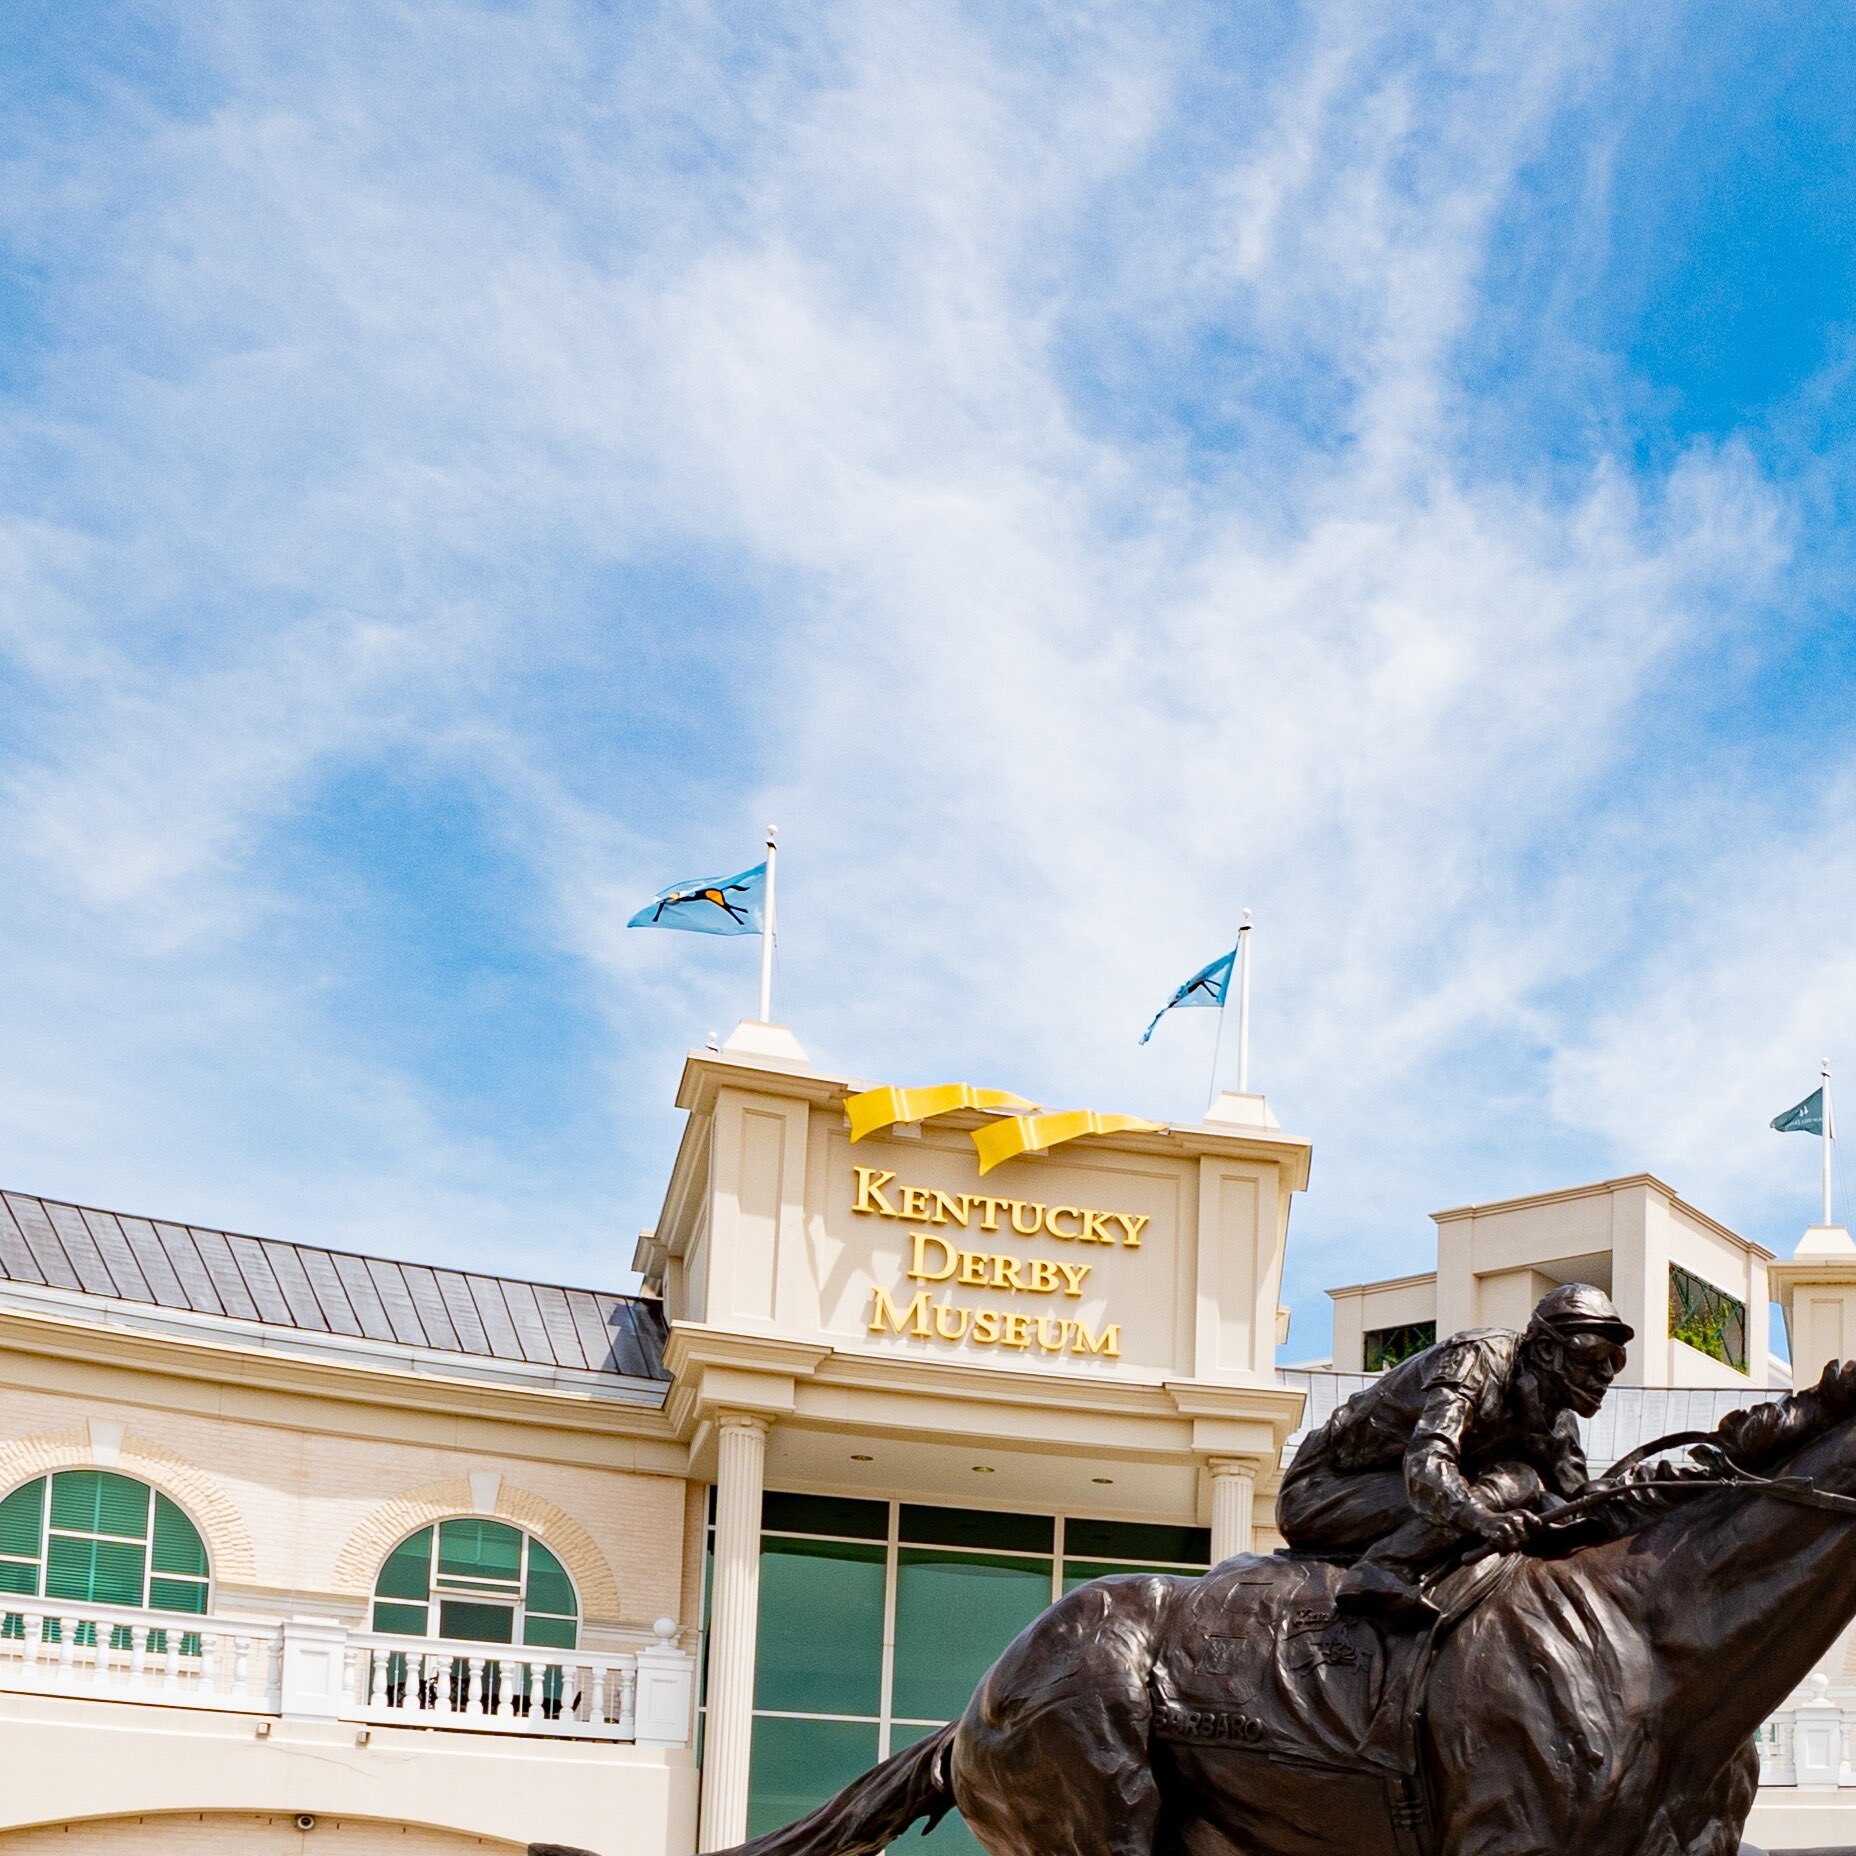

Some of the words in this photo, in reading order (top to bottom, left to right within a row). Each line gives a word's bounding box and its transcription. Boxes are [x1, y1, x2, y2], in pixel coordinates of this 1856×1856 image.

[852, 1166, 1149, 1246] KENTUCKY
[907, 1231, 1092, 1295] DERBY
[868, 1284, 1121, 1356] MUSEUM
[1153, 1705, 1262, 1742] BARBARO
